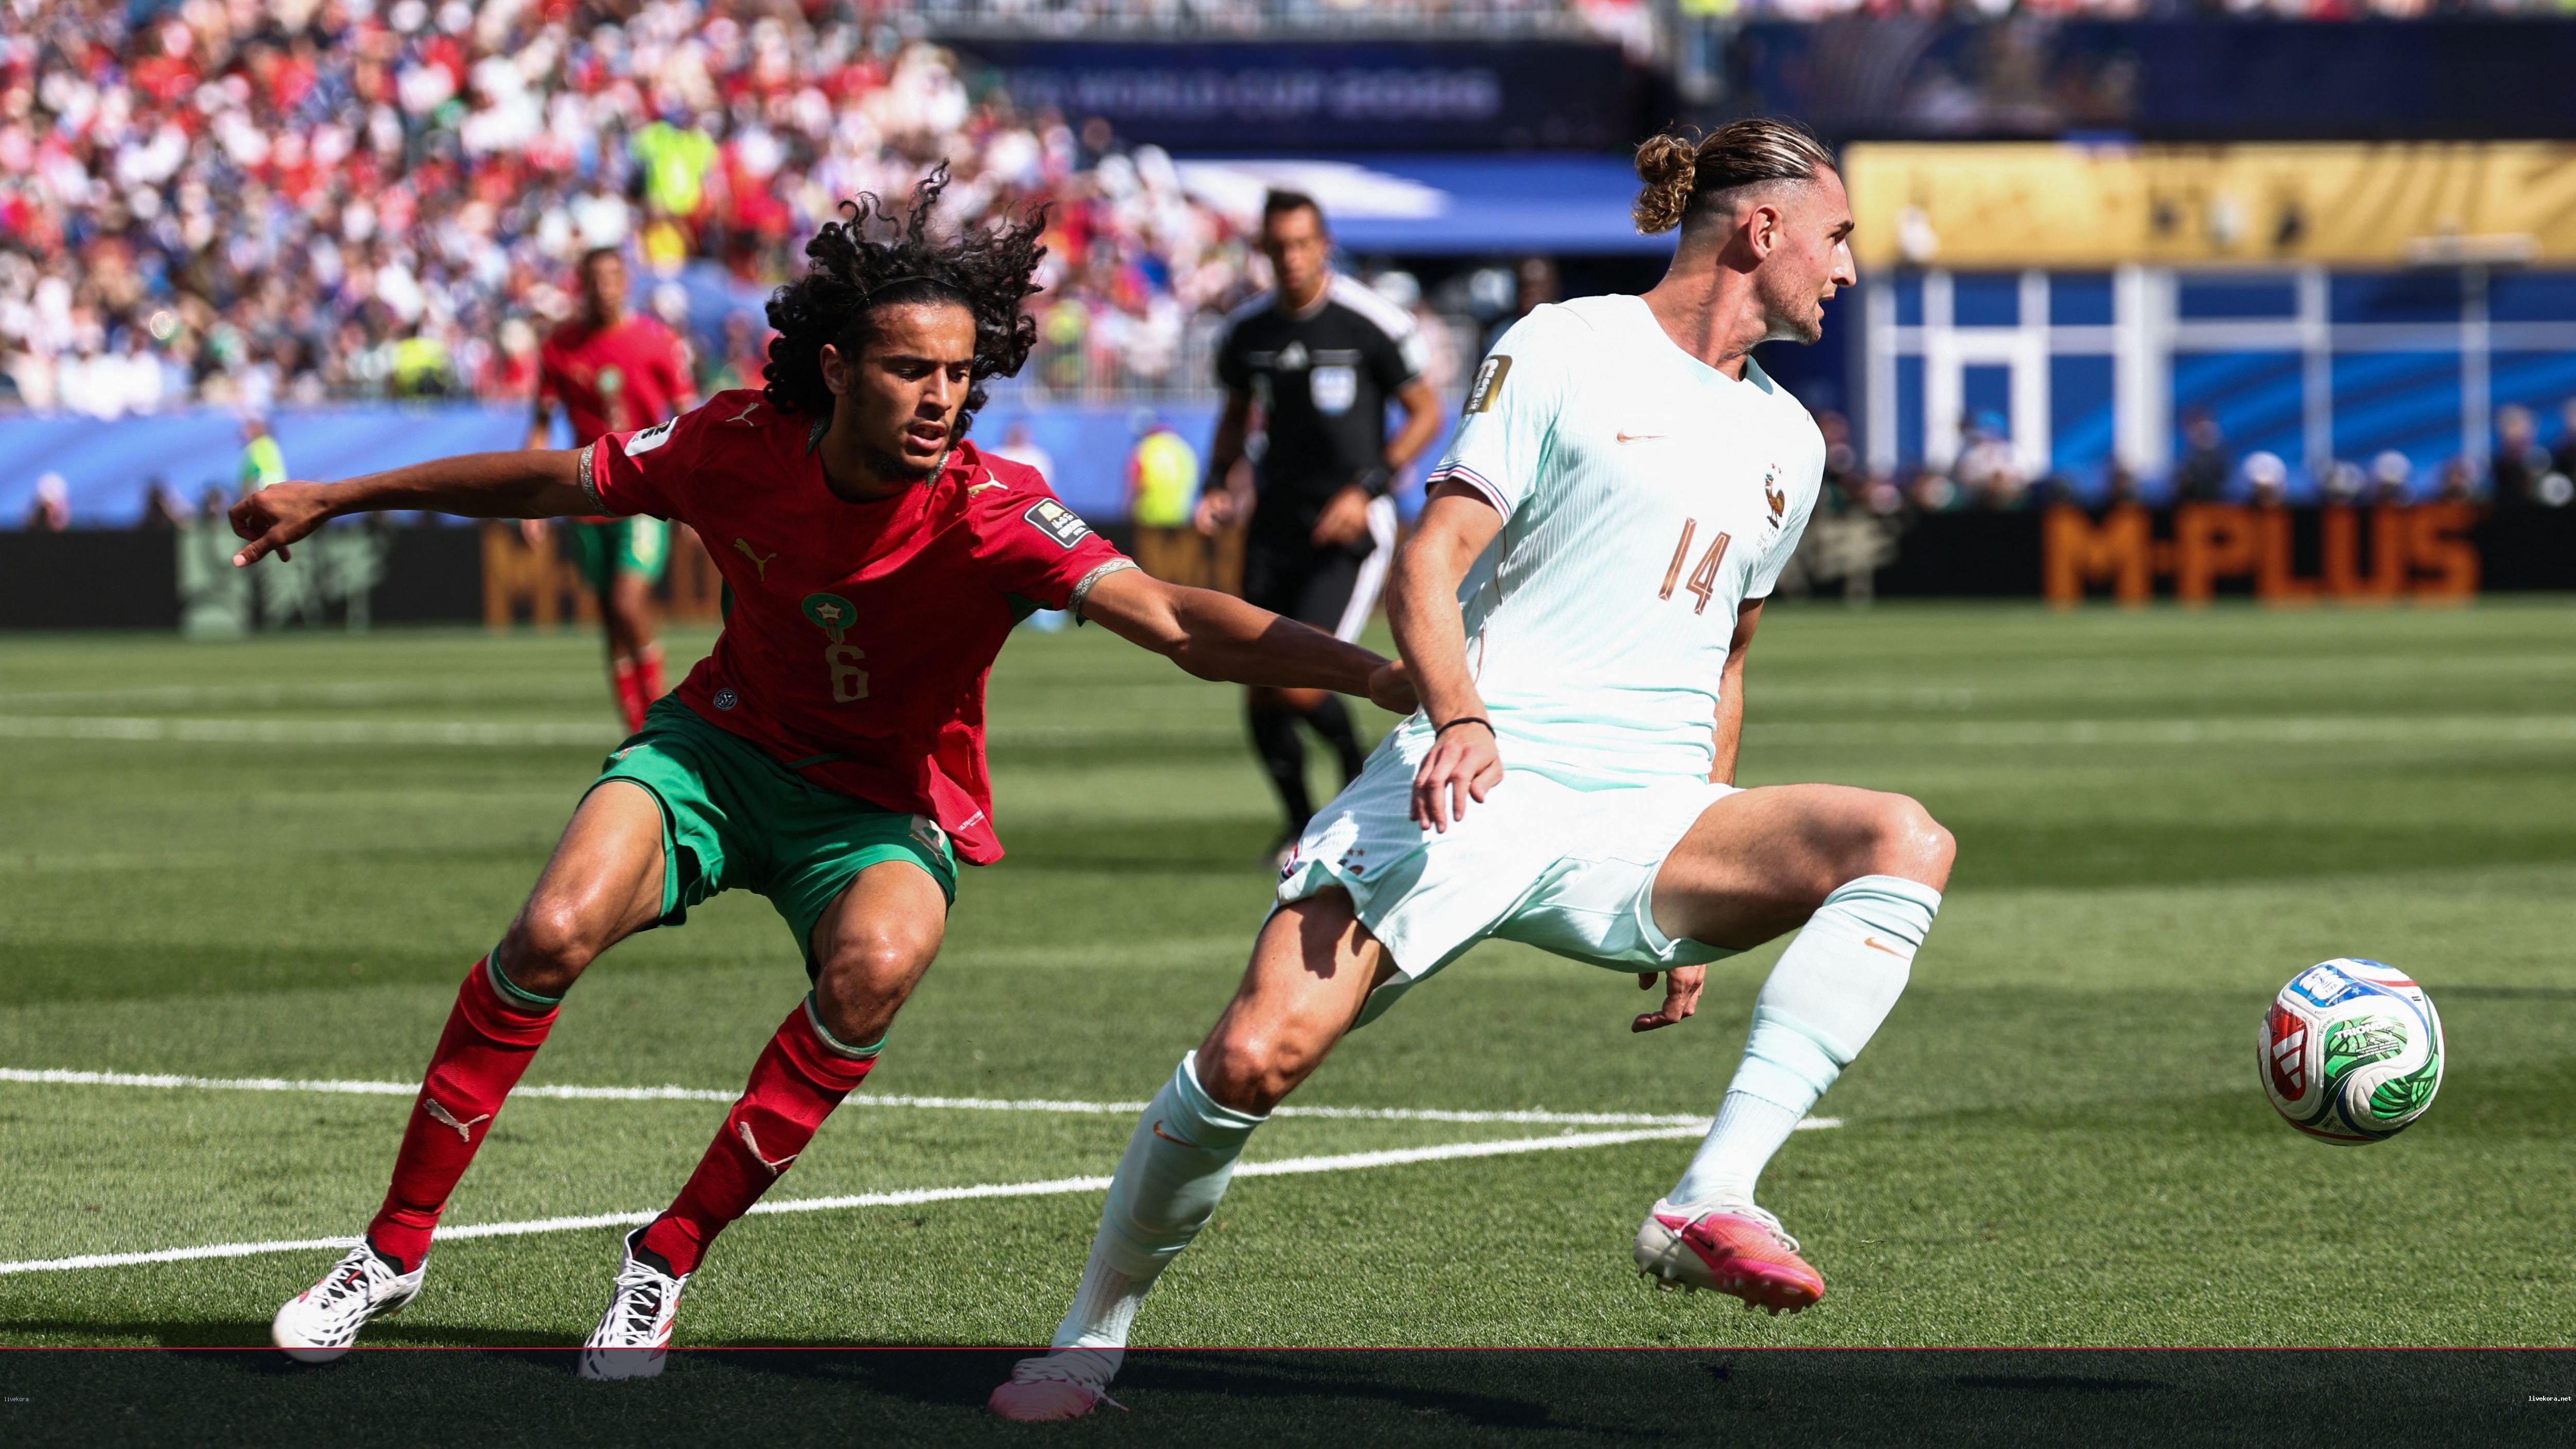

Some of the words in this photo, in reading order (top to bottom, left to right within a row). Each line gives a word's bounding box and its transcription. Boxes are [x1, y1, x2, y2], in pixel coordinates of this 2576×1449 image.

[1658, 516, 1732, 616] 14
[2042, 505, 2480, 607] M-PLUS
[825, 643, 869, 703] 6
